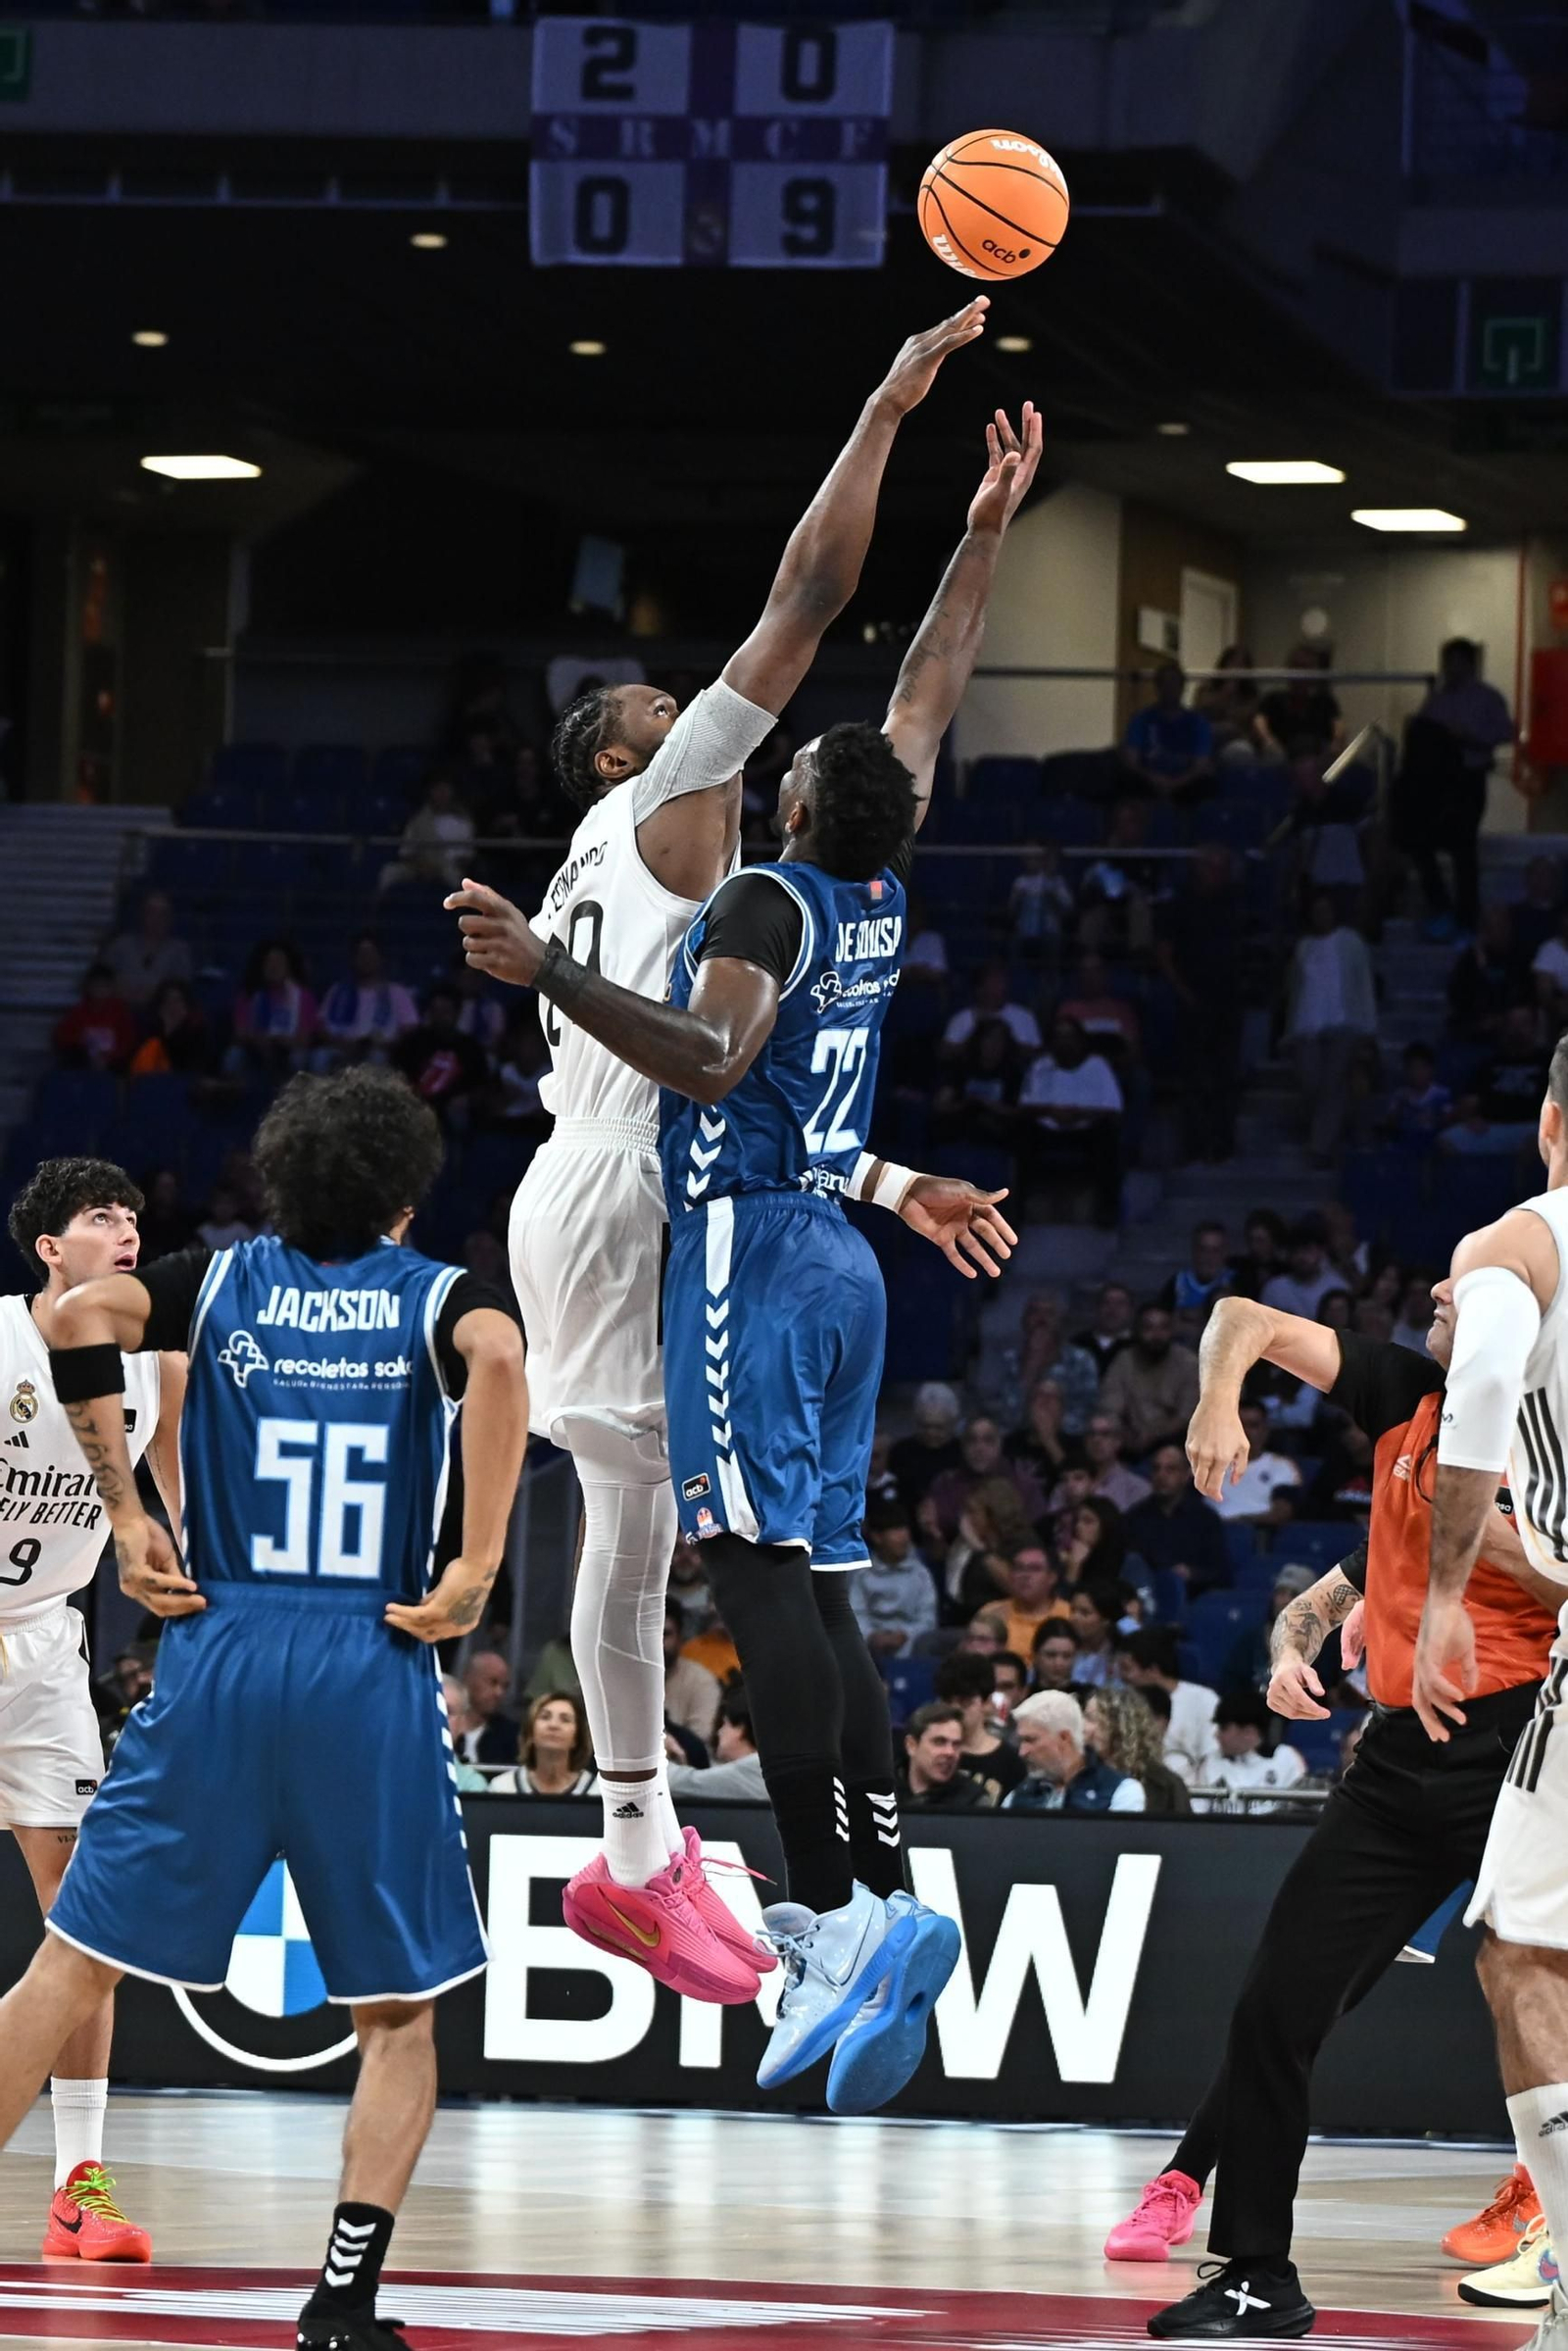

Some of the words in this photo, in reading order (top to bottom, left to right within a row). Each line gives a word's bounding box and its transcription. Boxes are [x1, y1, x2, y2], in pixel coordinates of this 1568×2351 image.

[582, 26, 635, 101] 2
[781, 27, 836, 104] 0
[574, 174, 631, 254] 0
[781, 176, 836, 255] 9
[982, 239, 1015, 264] acb
[803, 1027, 869, 1154] 22
[256, 1286, 400, 1332] JACKSON
[274, 1356, 368, 1379] recoletas
[251, 1417, 390, 1580] 56
[686, 1484, 704, 1497] acb
[29, 1501, 102, 1530] BETTER
[77, 1785, 94, 1793] acb
